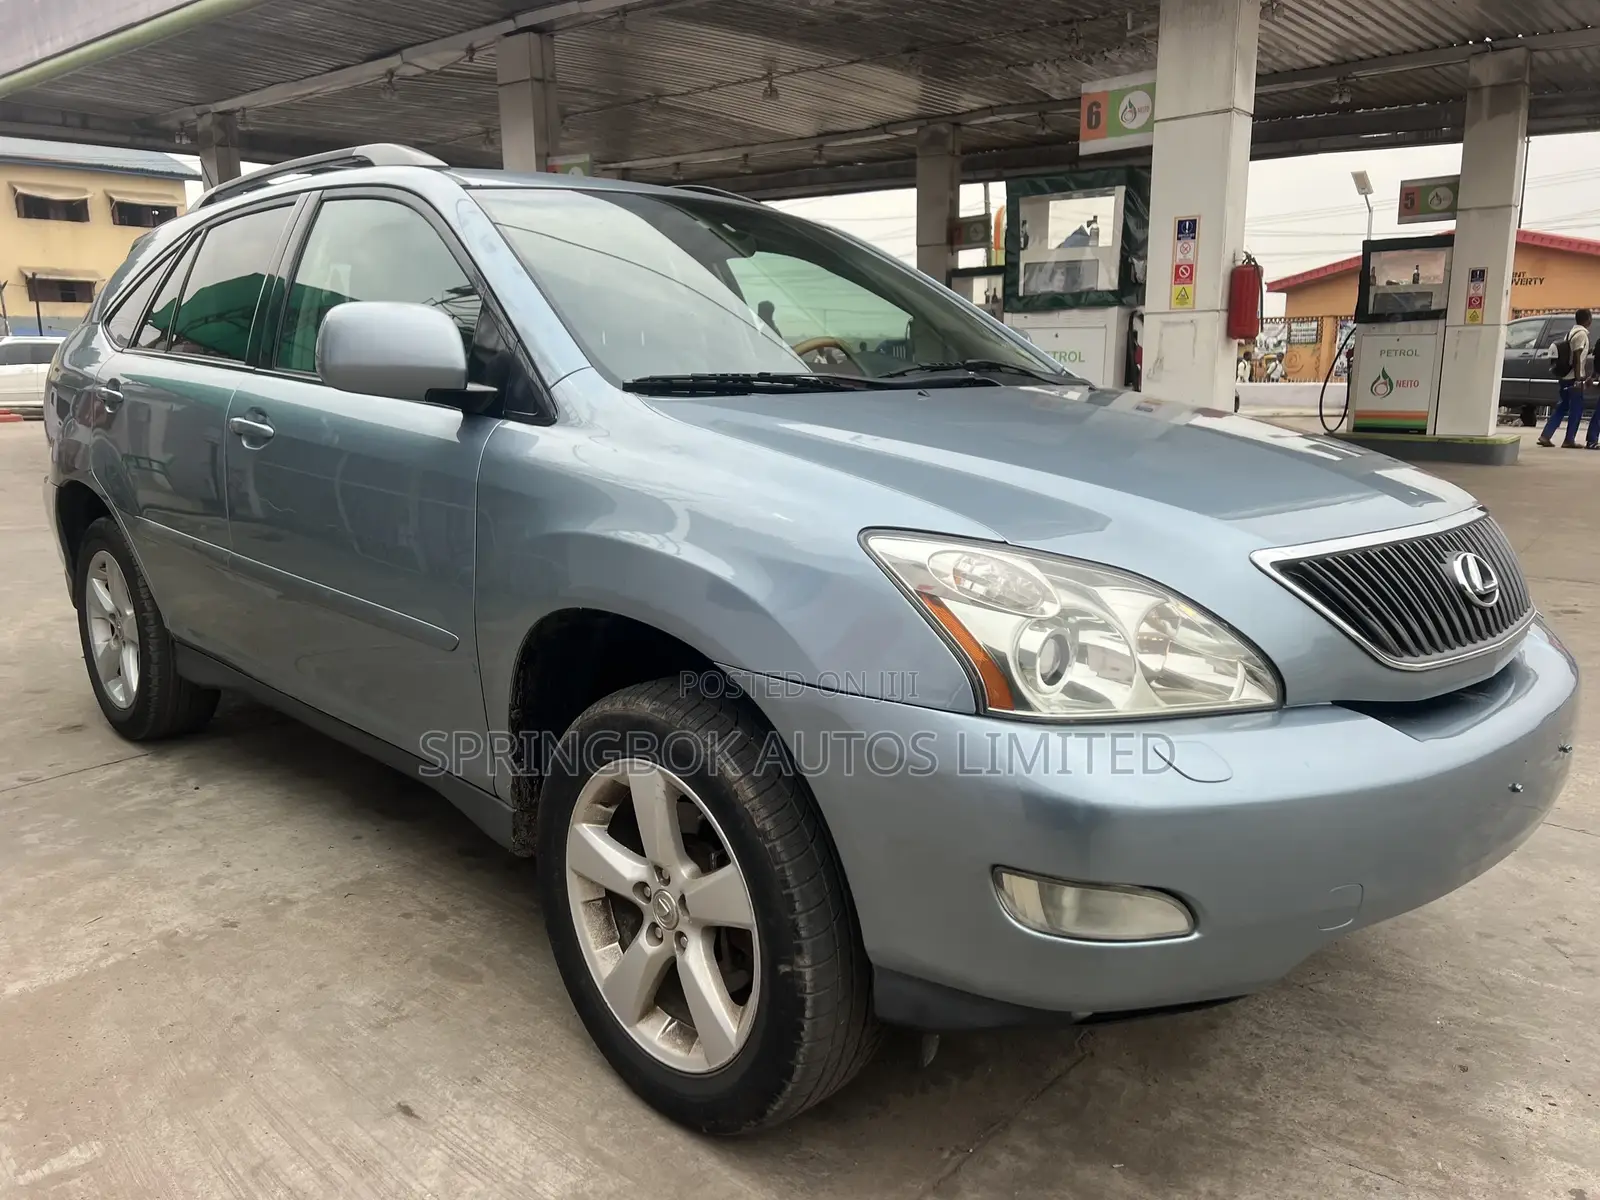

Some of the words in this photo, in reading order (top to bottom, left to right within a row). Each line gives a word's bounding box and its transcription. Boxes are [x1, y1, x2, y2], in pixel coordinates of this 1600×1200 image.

[1086, 101, 1101, 130] 6
[1403, 191, 1415, 210] 5
[1380, 349, 1420, 357] PETROL
[1395, 379, 1420, 388] NEITO
